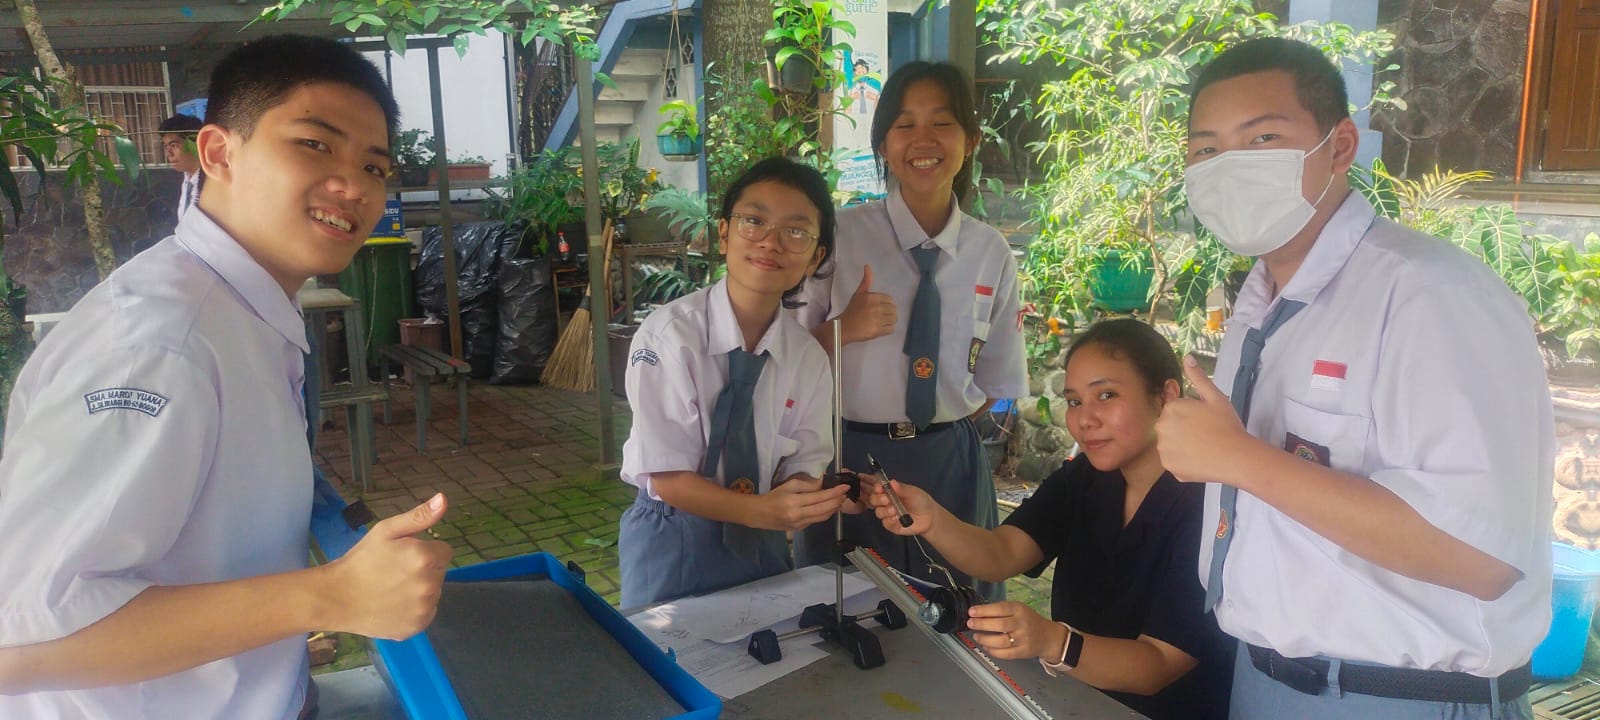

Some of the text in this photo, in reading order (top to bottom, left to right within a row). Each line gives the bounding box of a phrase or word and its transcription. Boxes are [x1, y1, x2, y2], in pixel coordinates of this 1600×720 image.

[90, 391, 162, 407] SMA MARDI YUANA
